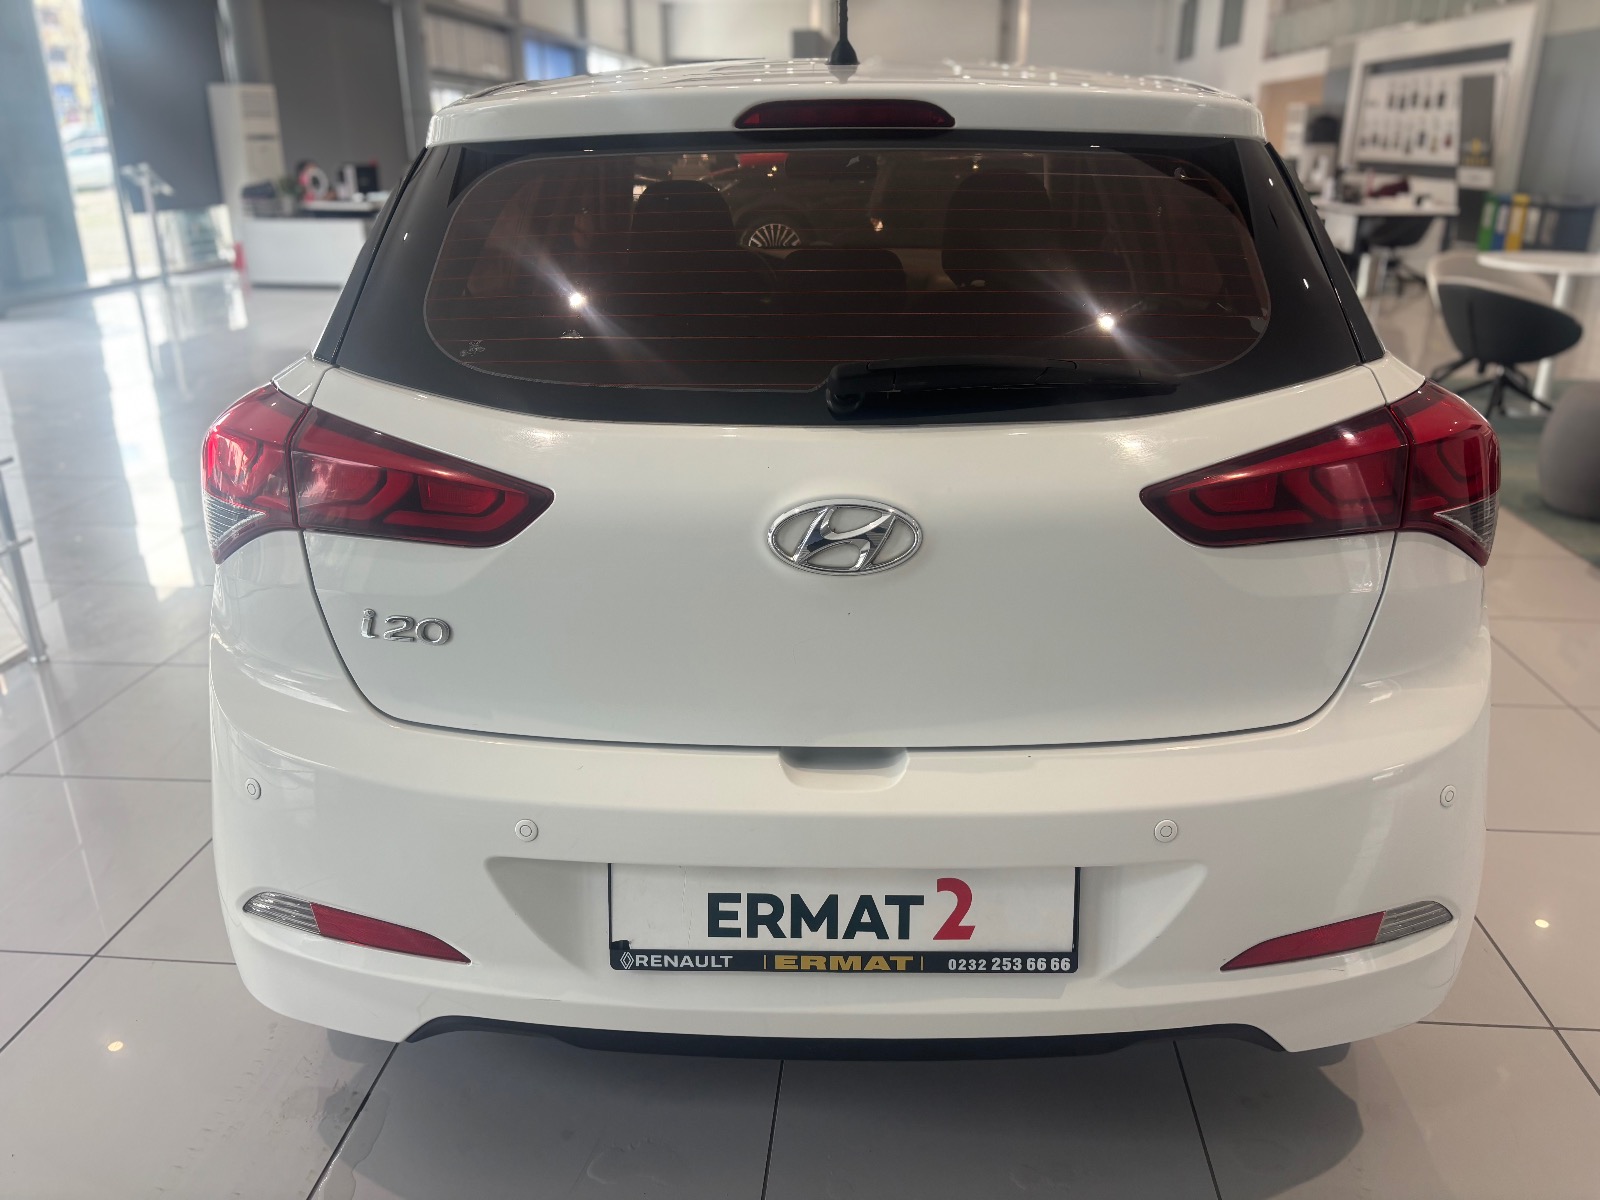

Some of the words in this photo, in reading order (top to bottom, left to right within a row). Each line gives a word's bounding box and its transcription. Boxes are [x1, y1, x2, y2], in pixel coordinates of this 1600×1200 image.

[361, 608, 451, 646] i20
[707, 892, 925, 940] ERMAT
[932, 877, 976, 941] 2
[635, 954, 734, 969] RENAULT
[774, 955, 914, 972] ERMAT
[948, 958, 987, 971] 0232
[991, 957, 1023, 971] 253
[1026, 957, 1047, 971] 66
[1050, 957, 1071, 972] 66
